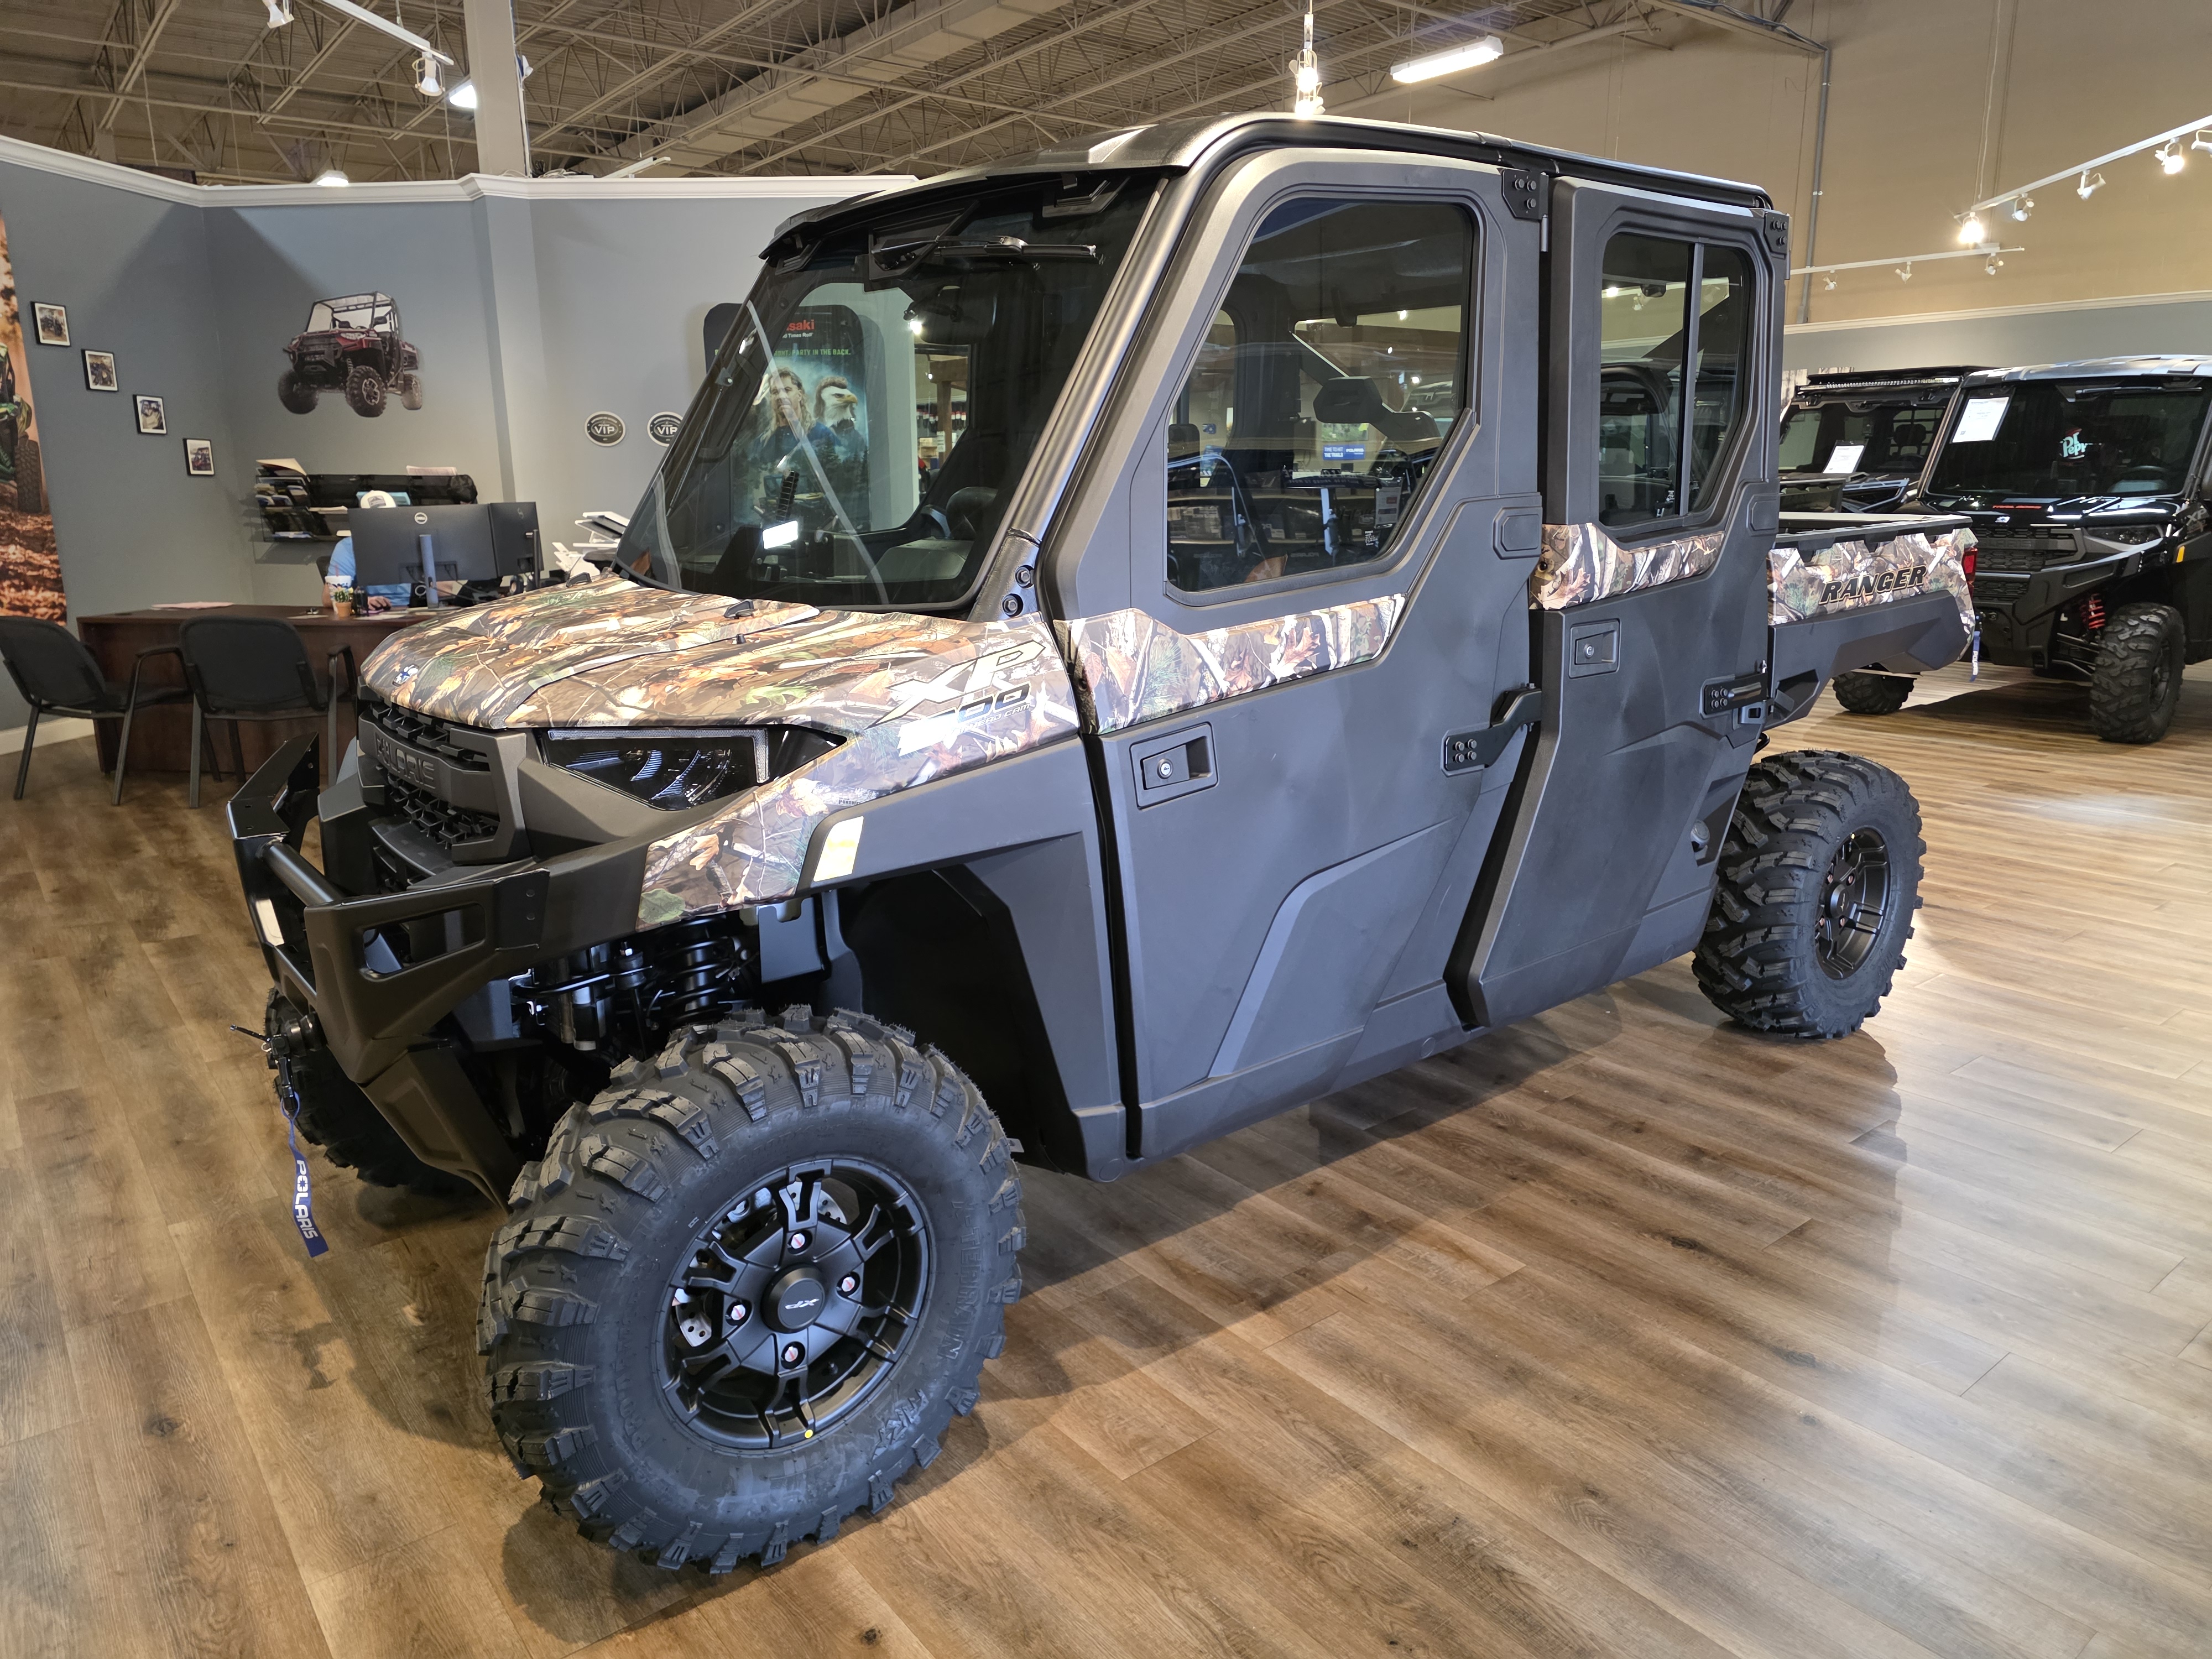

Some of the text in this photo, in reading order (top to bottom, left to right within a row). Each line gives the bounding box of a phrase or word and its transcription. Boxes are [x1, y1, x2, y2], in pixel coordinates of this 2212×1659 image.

[786, 319, 815, 331] saki
[594, 426, 615, 435] VIP
[657, 426, 678, 435] VIP
[1818, 565, 1927, 605] RANGER
[864, 640, 1046, 731] XP
[1004, 703, 1031, 718] CAM
[295, 1160, 319, 1239] POLARIS
[785, 1298, 820, 1310] XP
